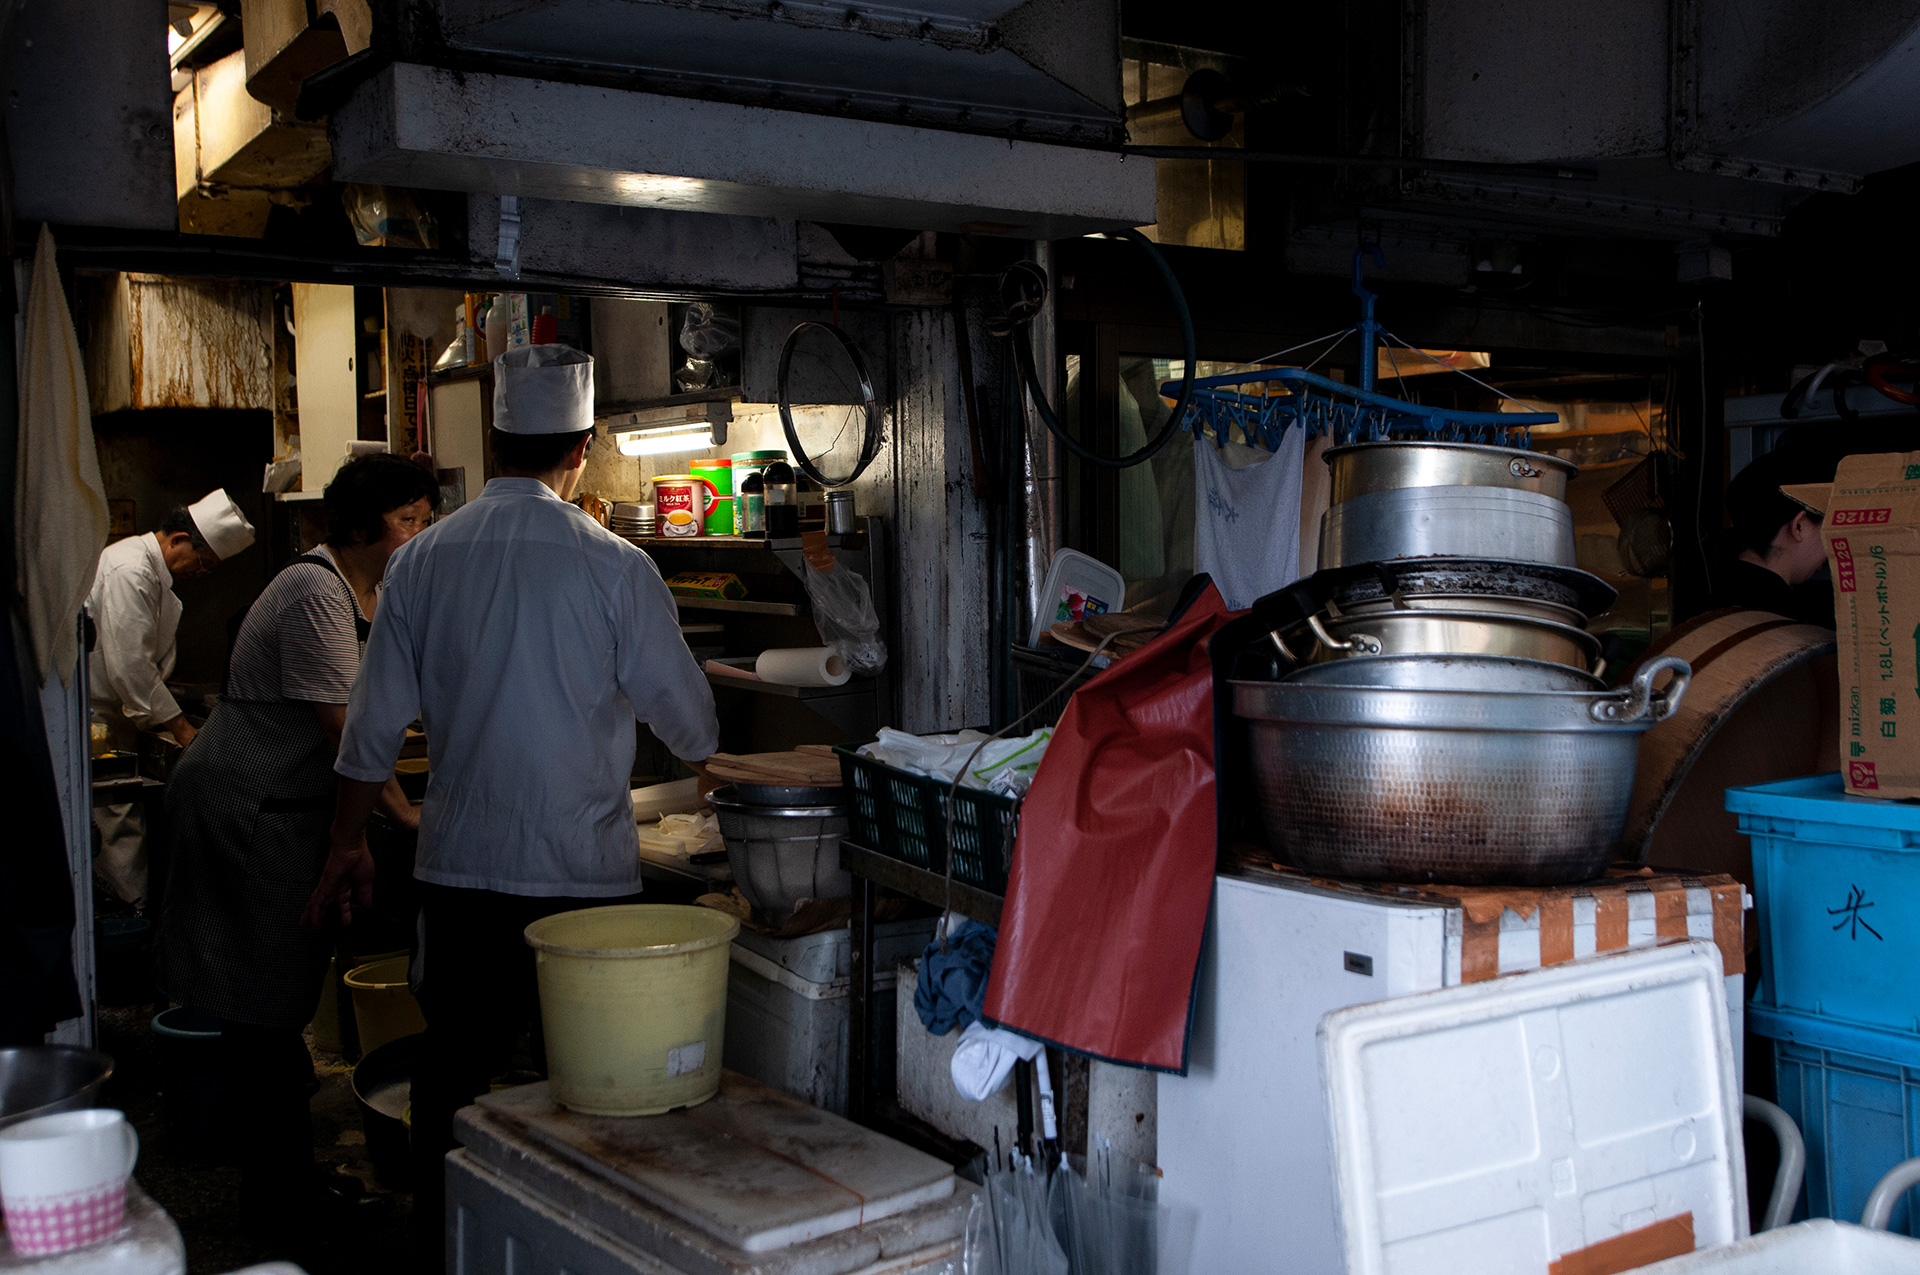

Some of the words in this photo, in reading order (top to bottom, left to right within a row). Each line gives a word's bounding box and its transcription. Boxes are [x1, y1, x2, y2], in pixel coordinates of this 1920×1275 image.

[659, 494, 690, 503] ミルク紅茶
[1835, 509, 1888, 524] 21126
[1834, 540, 1854, 590] 21126
[1848, 685, 1861, 737] mizkan
[1821, 883, 1883, 941] 米
